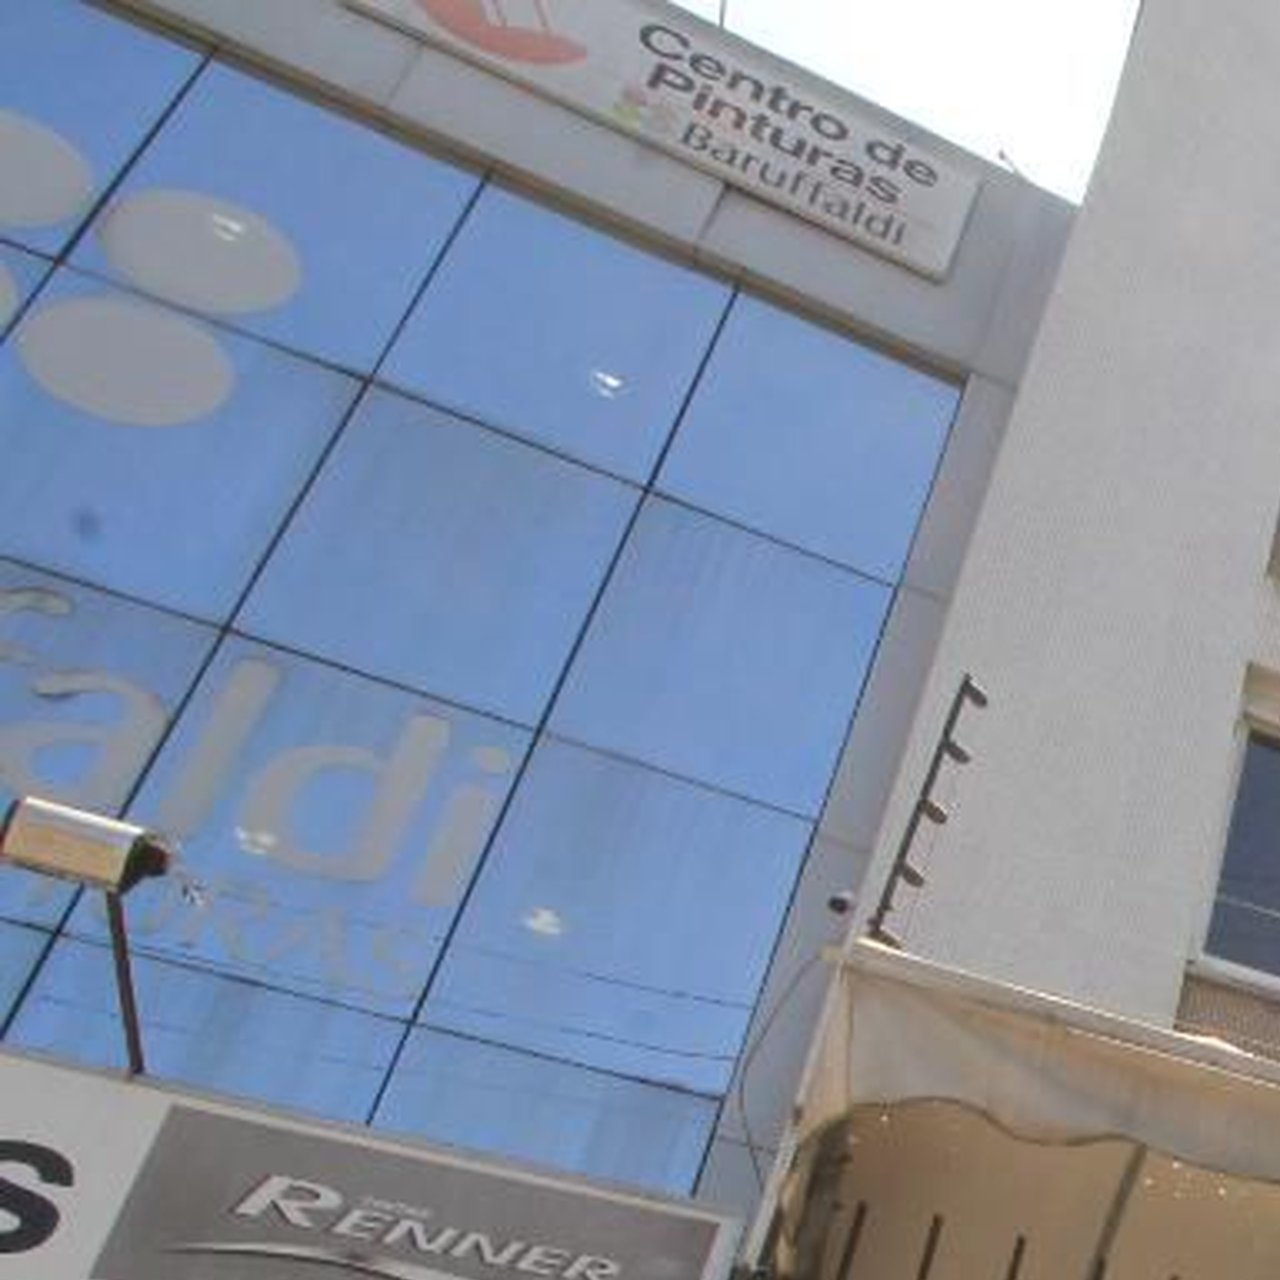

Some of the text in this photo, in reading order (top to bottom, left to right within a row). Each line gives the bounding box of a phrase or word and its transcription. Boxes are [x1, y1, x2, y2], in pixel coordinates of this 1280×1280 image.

[639, 24, 940, 190] Centro de
[647, 62, 904, 204] Pinturas
